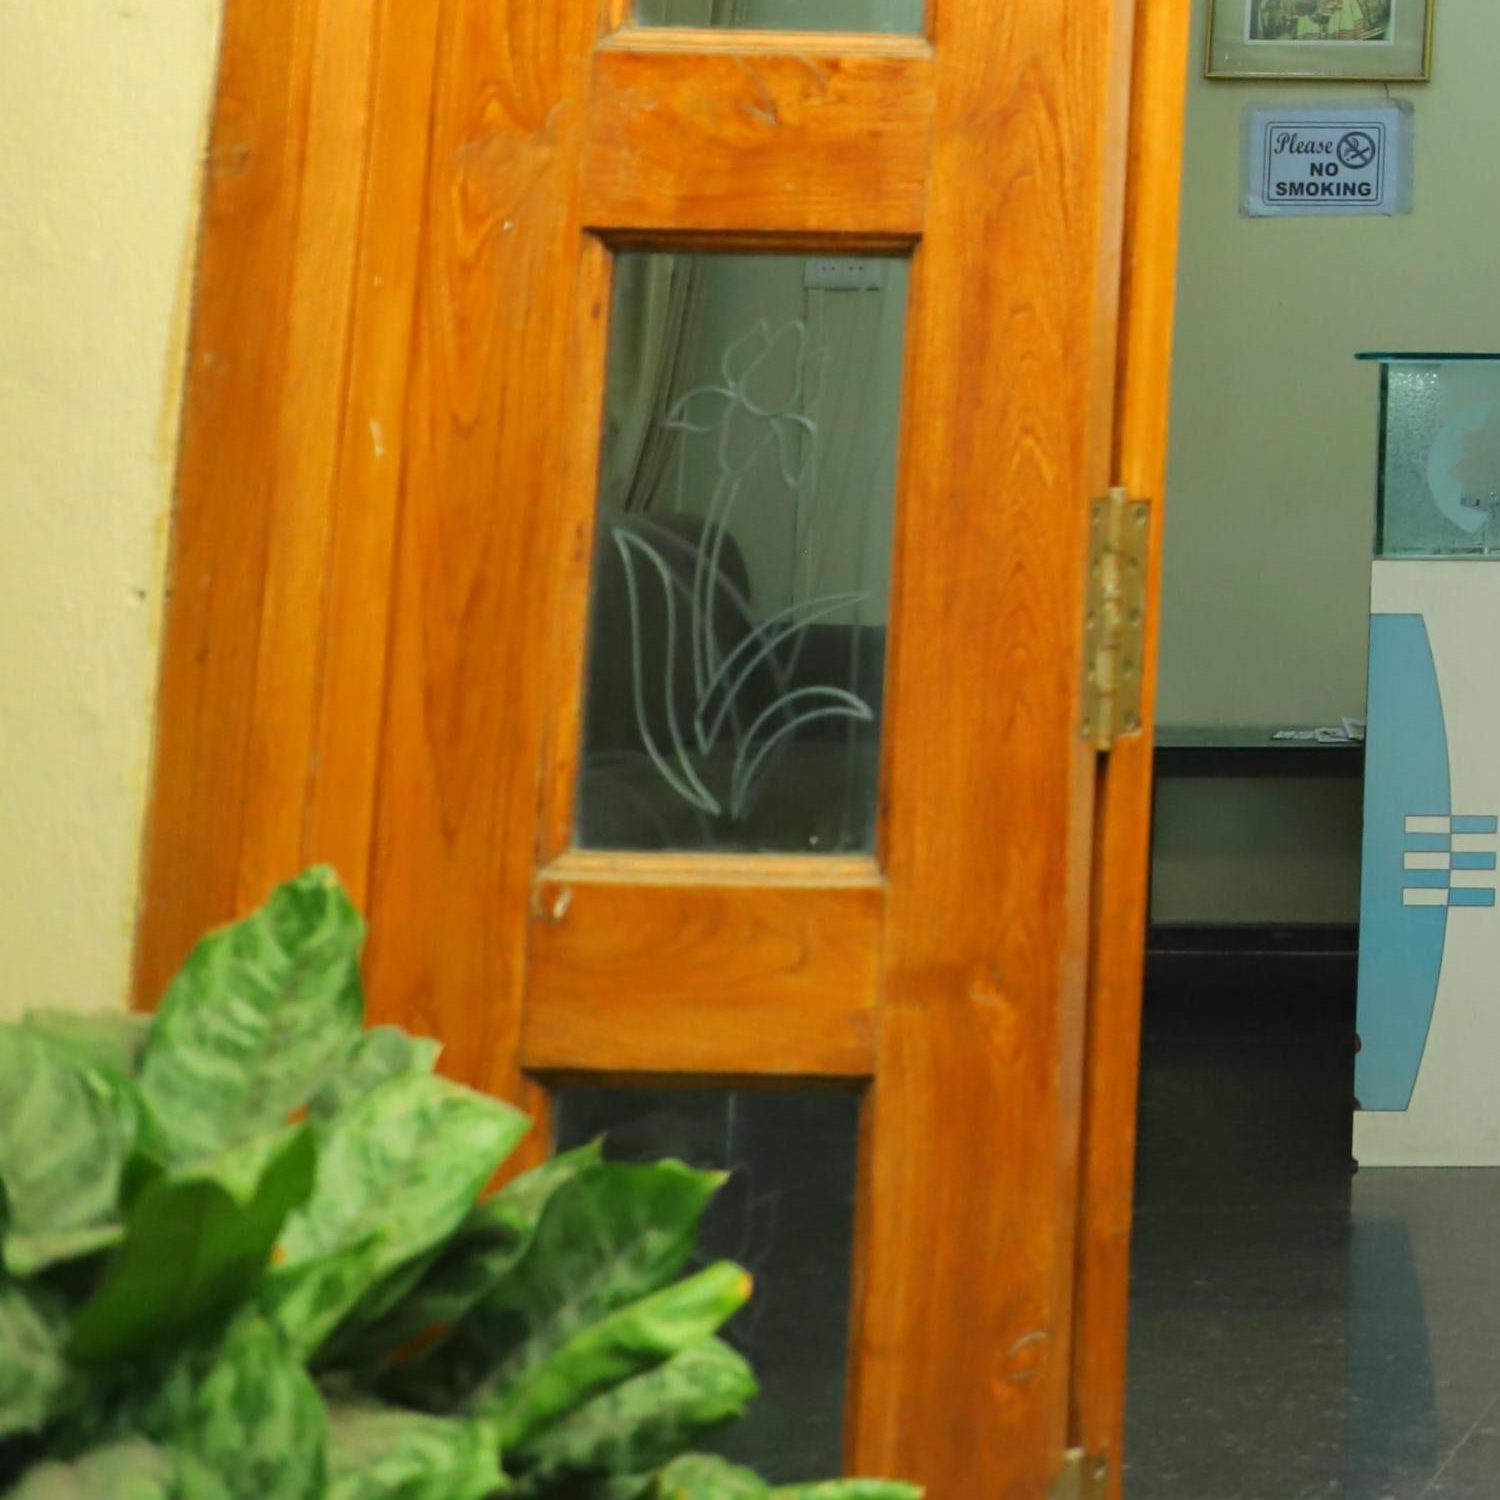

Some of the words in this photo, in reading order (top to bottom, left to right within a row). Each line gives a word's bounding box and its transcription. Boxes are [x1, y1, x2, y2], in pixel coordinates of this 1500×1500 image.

[1273, 132, 1333, 155] Please
[1310, 162, 1338, 176] NO
[1276, 182, 1371, 196] SMOKING
